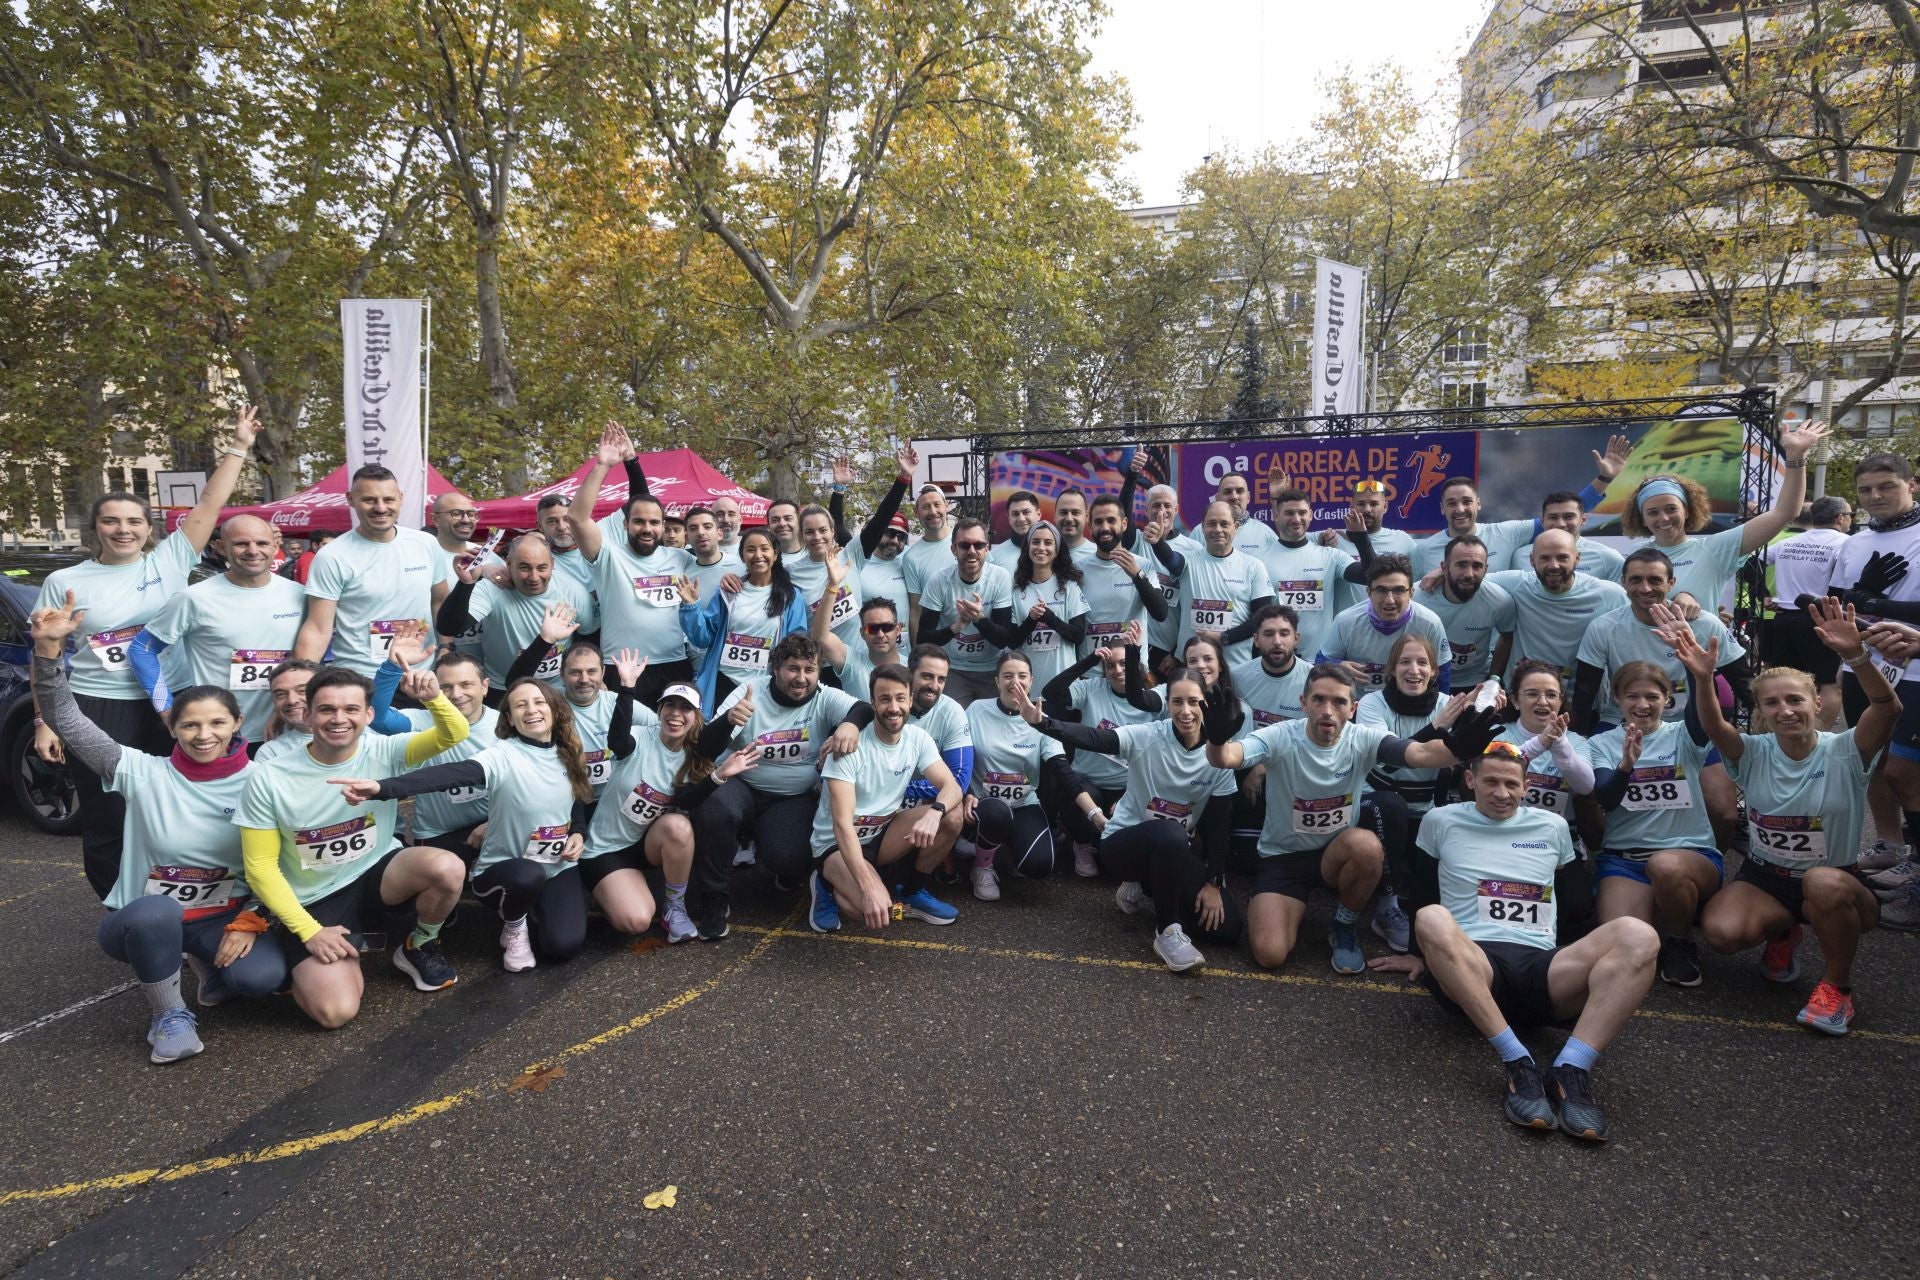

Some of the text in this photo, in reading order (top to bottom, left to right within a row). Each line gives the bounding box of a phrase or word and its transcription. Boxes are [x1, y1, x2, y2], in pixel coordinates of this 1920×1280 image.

[1254, 447, 1399, 476] CARRERA DE
[1254, 473, 1398, 505] EPRESS
[1313, 507, 1352, 521] Castill
[1284, 592, 1317, 605] 793
[1195, 611, 1224, 625] 801
[728, 646, 761, 663] 851
[956, 641, 985, 653] 785
[240, 665, 270, 683] 84
[763, 743, 801, 759] 810
[989, 785, 1023, 800] 846
[1627, 782, 1679, 802] 838
[1302, 809, 1343, 828] 823
[309, 833, 367, 860] 796
[537, 841, 564, 856] 79
[1511, 842, 1548, 850] OneHealth
[1756, 828, 1812, 852] 822
[1489, 899, 1538, 924] 821
